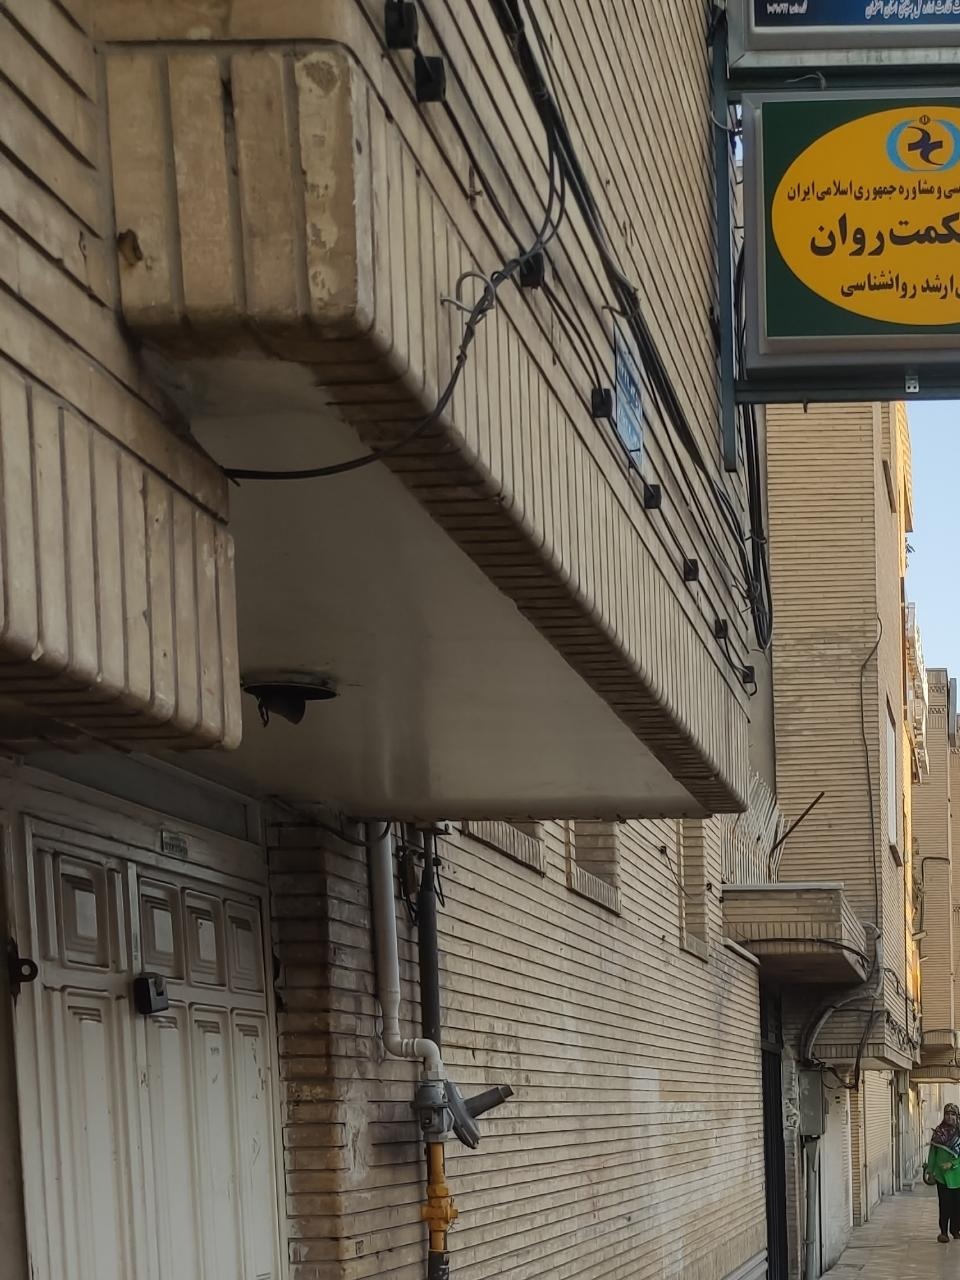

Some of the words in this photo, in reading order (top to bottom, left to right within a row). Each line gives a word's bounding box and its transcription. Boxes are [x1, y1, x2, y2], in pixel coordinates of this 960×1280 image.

[787, 180, 815, 202] ایران
[815, 179, 853, 201] اسلامی
[853, 183, 897, 201] جمهوری
[898, 178, 935, 200] مشاوره
[809, 212, 885, 256] روان
[840, 270, 917, 299] روانشناسی
[921, 273, 954, 300] ارشد
